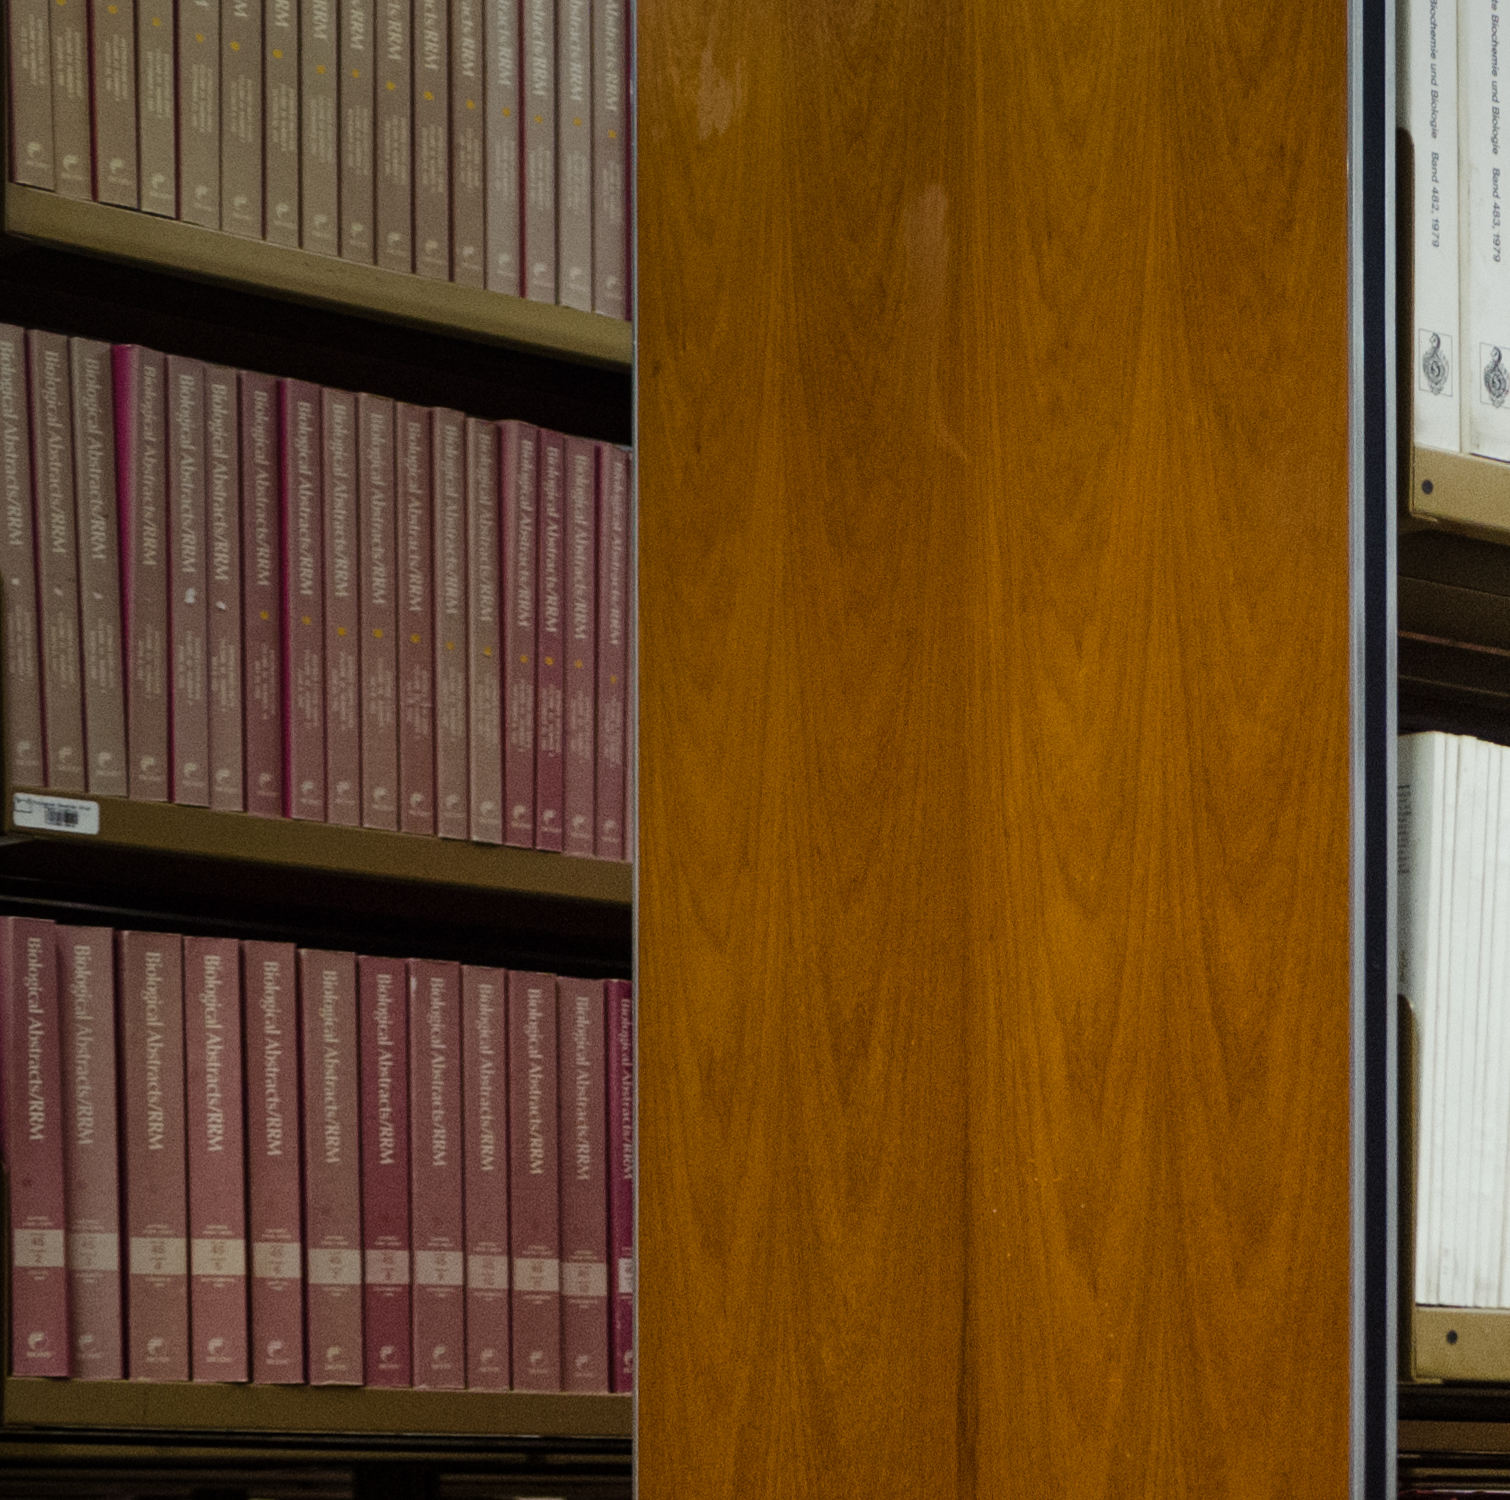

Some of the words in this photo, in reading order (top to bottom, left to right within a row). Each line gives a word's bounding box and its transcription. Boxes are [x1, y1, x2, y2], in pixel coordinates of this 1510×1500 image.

[1491, 14, 1499, 77] Biochemie
[1491, 107, 1500, 155] Biologie
[1492, 168, 1500, 198] Band
[1492, 202, 1501, 229] 483,
[1493, 234, 1501, 262] 1979
[174, 373, 198, 452] Biological
[181, 452, 197, 573] Abstracts/RRM
[24, 936, 46, 1015] Biological
[140, 950, 165, 1028] Biological
[258, 959, 283, 1036] Biological
[28, 1017, 46, 1142] Abstracts/RRM
[147, 1030, 164, 1150] Abstracts/RRM
[264, 1038, 283, 1156] Abstracts/RRM
